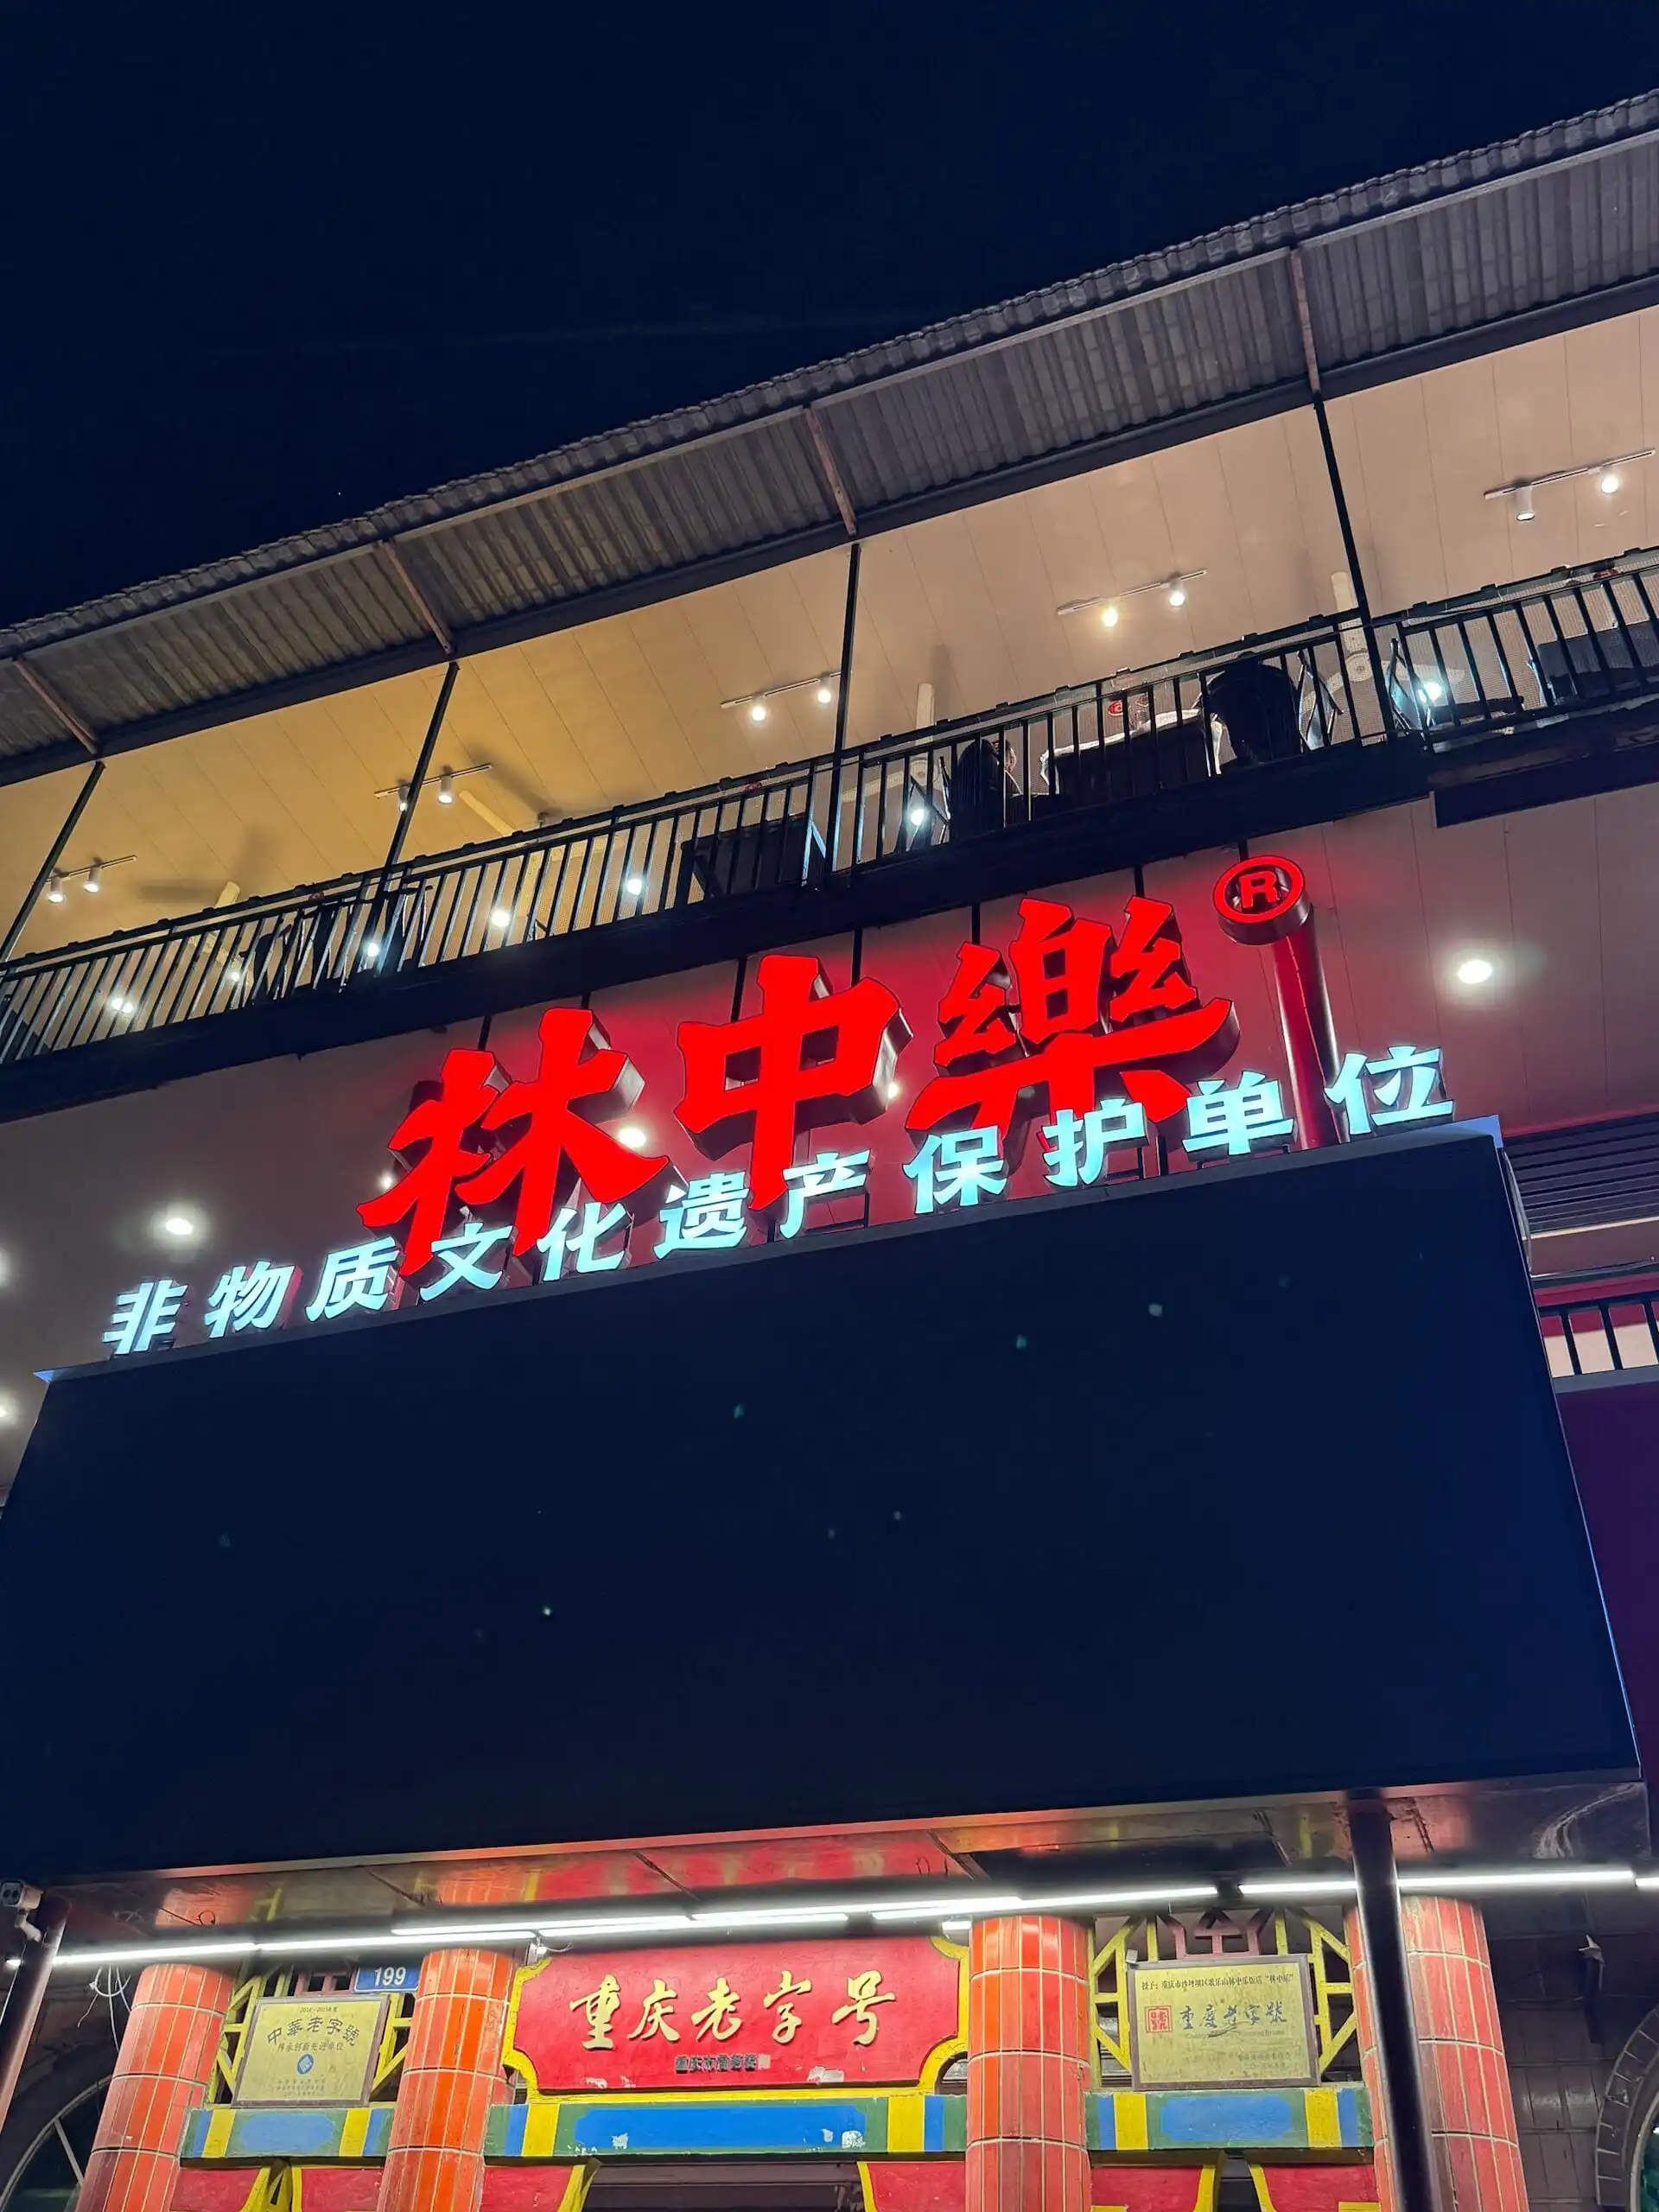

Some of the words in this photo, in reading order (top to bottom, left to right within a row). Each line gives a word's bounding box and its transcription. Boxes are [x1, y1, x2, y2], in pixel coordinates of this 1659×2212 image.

[102, 1045, 1455, 1355] 非物质文化遗产保护单位
[375, 1967, 406, 1986] 199
[267, 2016, 360, 2047] 中華老字號
[569, 1969, 897, 2050] 重庆老字号
